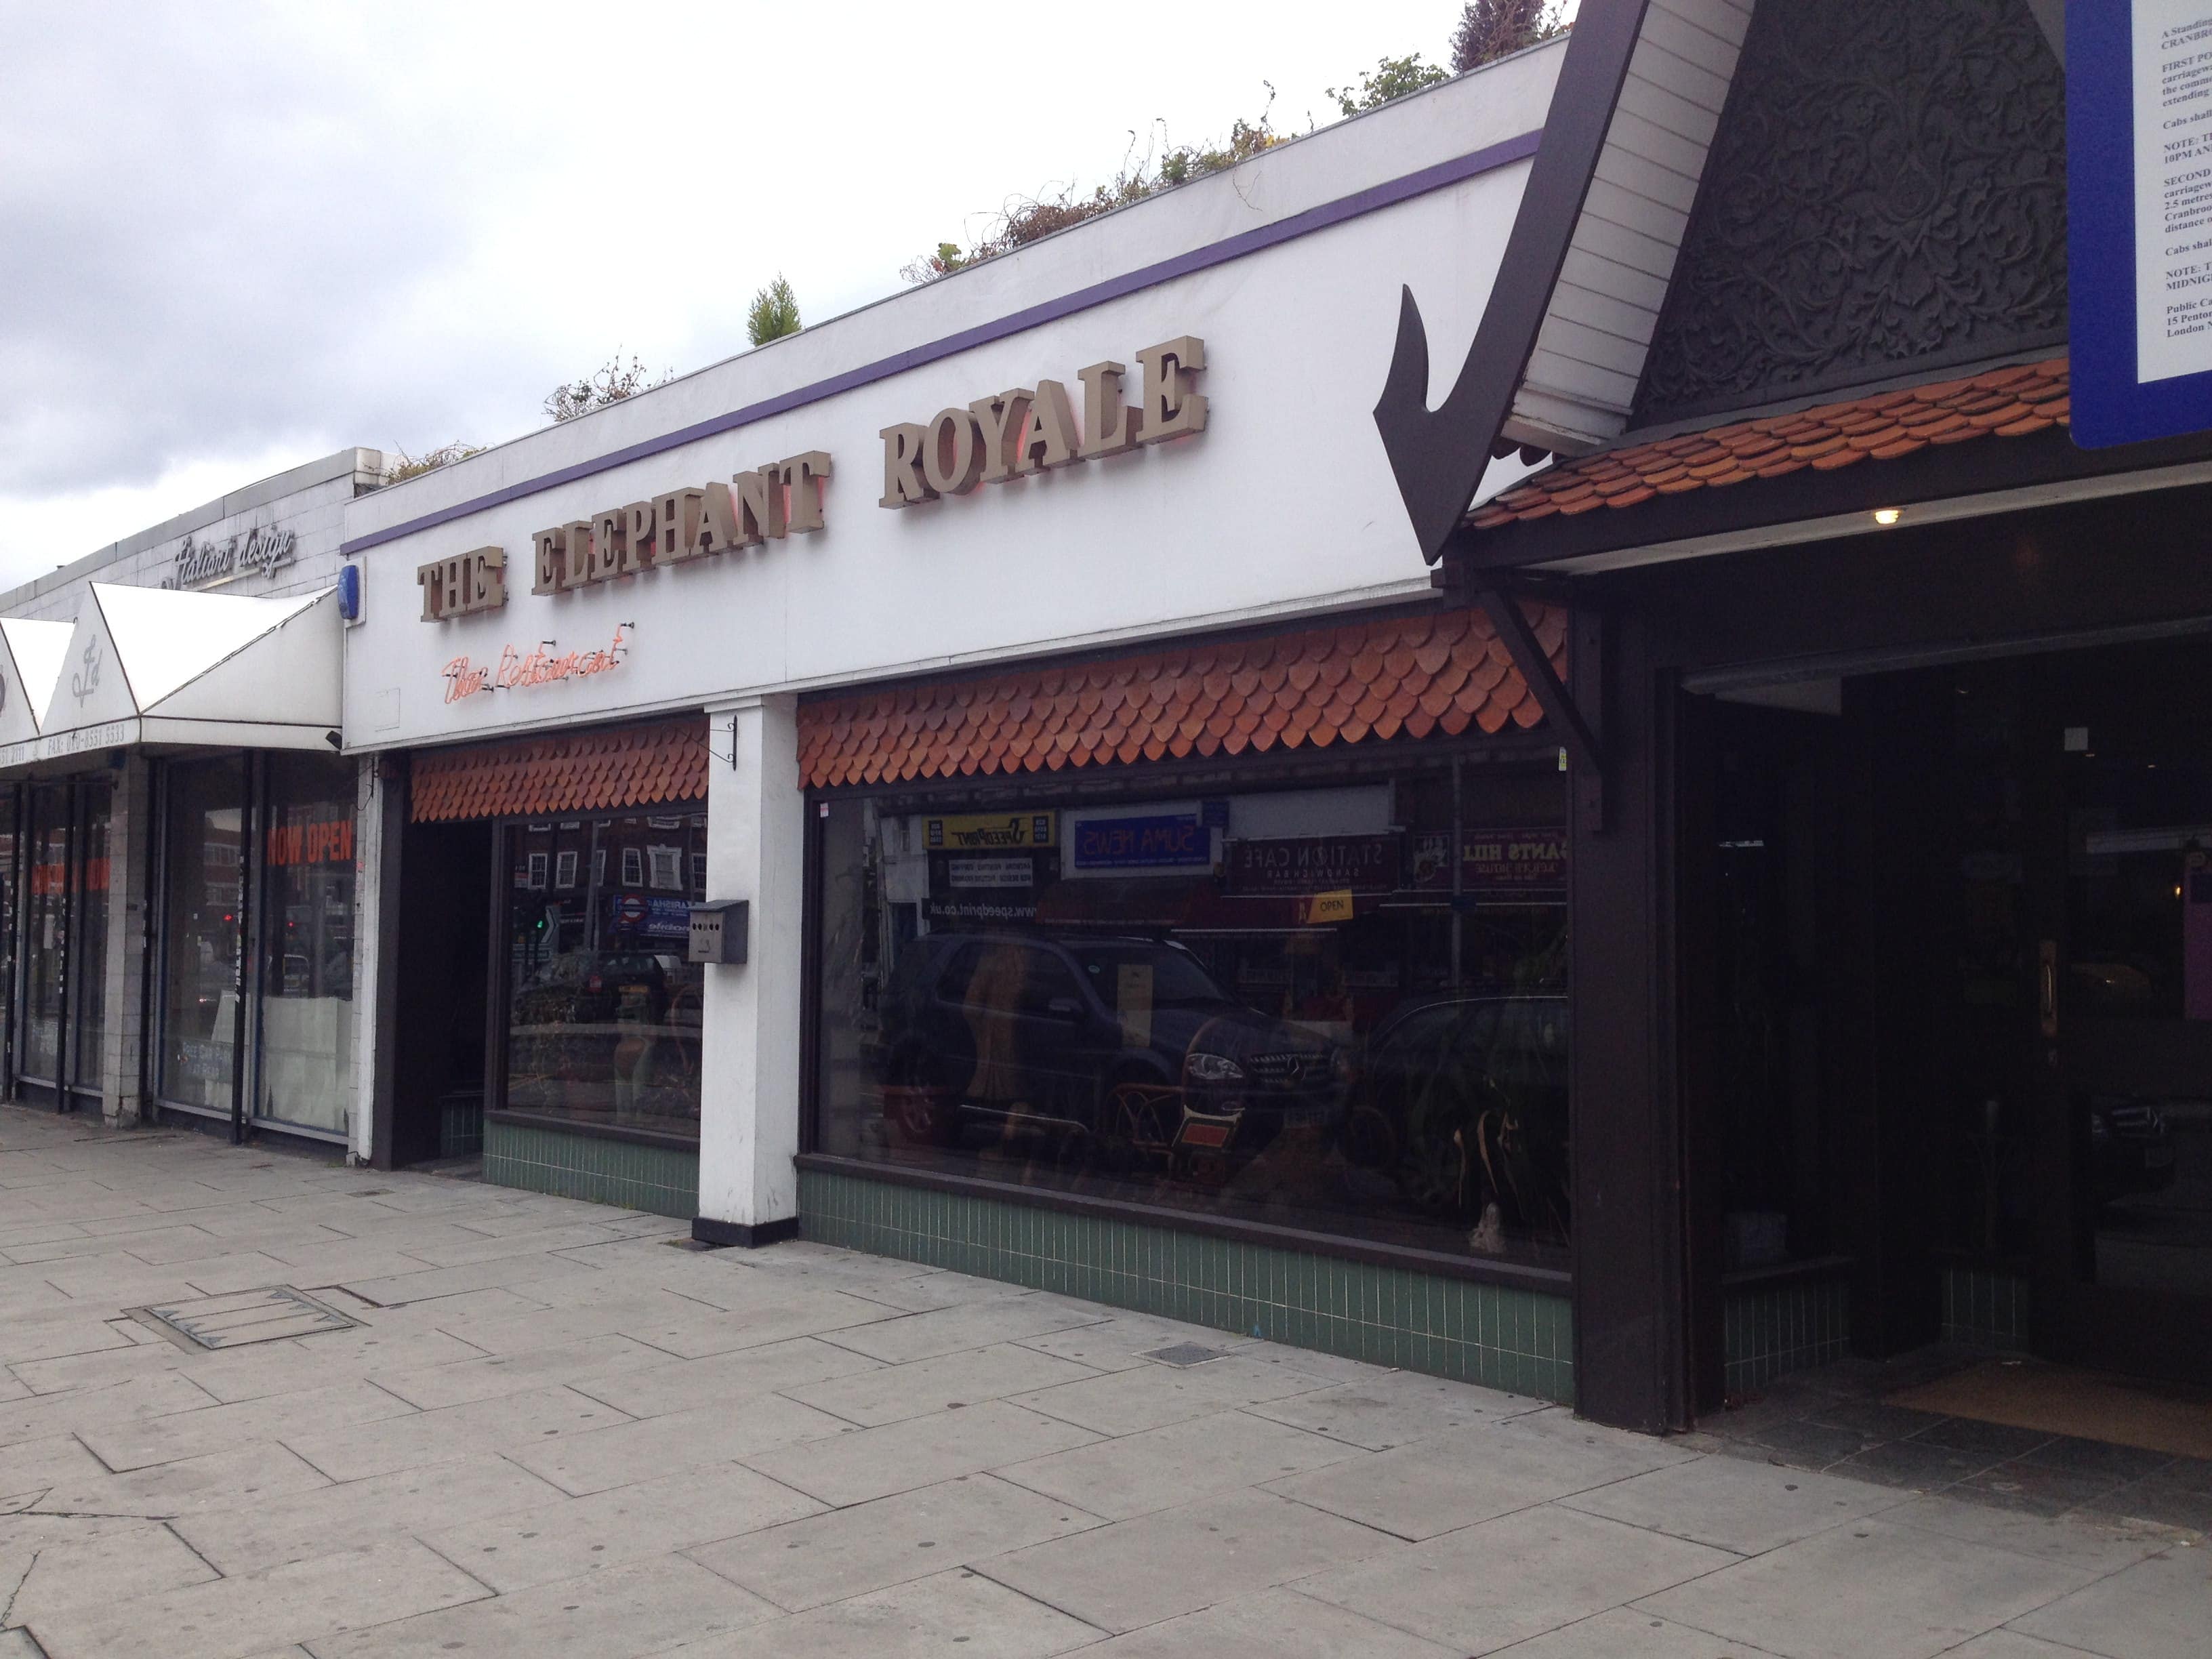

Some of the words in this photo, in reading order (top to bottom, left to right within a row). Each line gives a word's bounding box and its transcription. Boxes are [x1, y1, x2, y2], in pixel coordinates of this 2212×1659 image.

[2162, 30, 2169, 39] A
[2162, 56, 2195, 73] FIRST
[2162, 86, 2177, 96] the
[2163, 88, 2210, 107] extending
[2163, 117, 2187, 129] Cabs
[2164, 137, 2199, 153] NOTE:
[2165, 150, 2192, 164] 10PM
[2194, 143, 2212, 157] AN
[2164, 168, 2211, 187] SECOND
[2165, 199, 2179, 210] 2.5
[2165, 217, 2205, 233] distance
[2165, 245, 2190, 256] Cabs
[2166, 265, 2201, 280] NOTE:
[2166, 273, 2212, 291] MIDNIG
[2167, 301, 2197, 314] Public
[2167, 316, 2178, 326] 15
[2167, 324, 2205, 338] London
[417, 546, 504, 623] THE
[531, 450, 832, 596] ELEPHANT
[879, 335, 1209, 510] ROYALE
[239, 525, 296, 579] design
[267, 825, 304, 866] NOW
[307, 820, 352, 863] OPEN
[1319, 899, 1345, 914] OPEN
